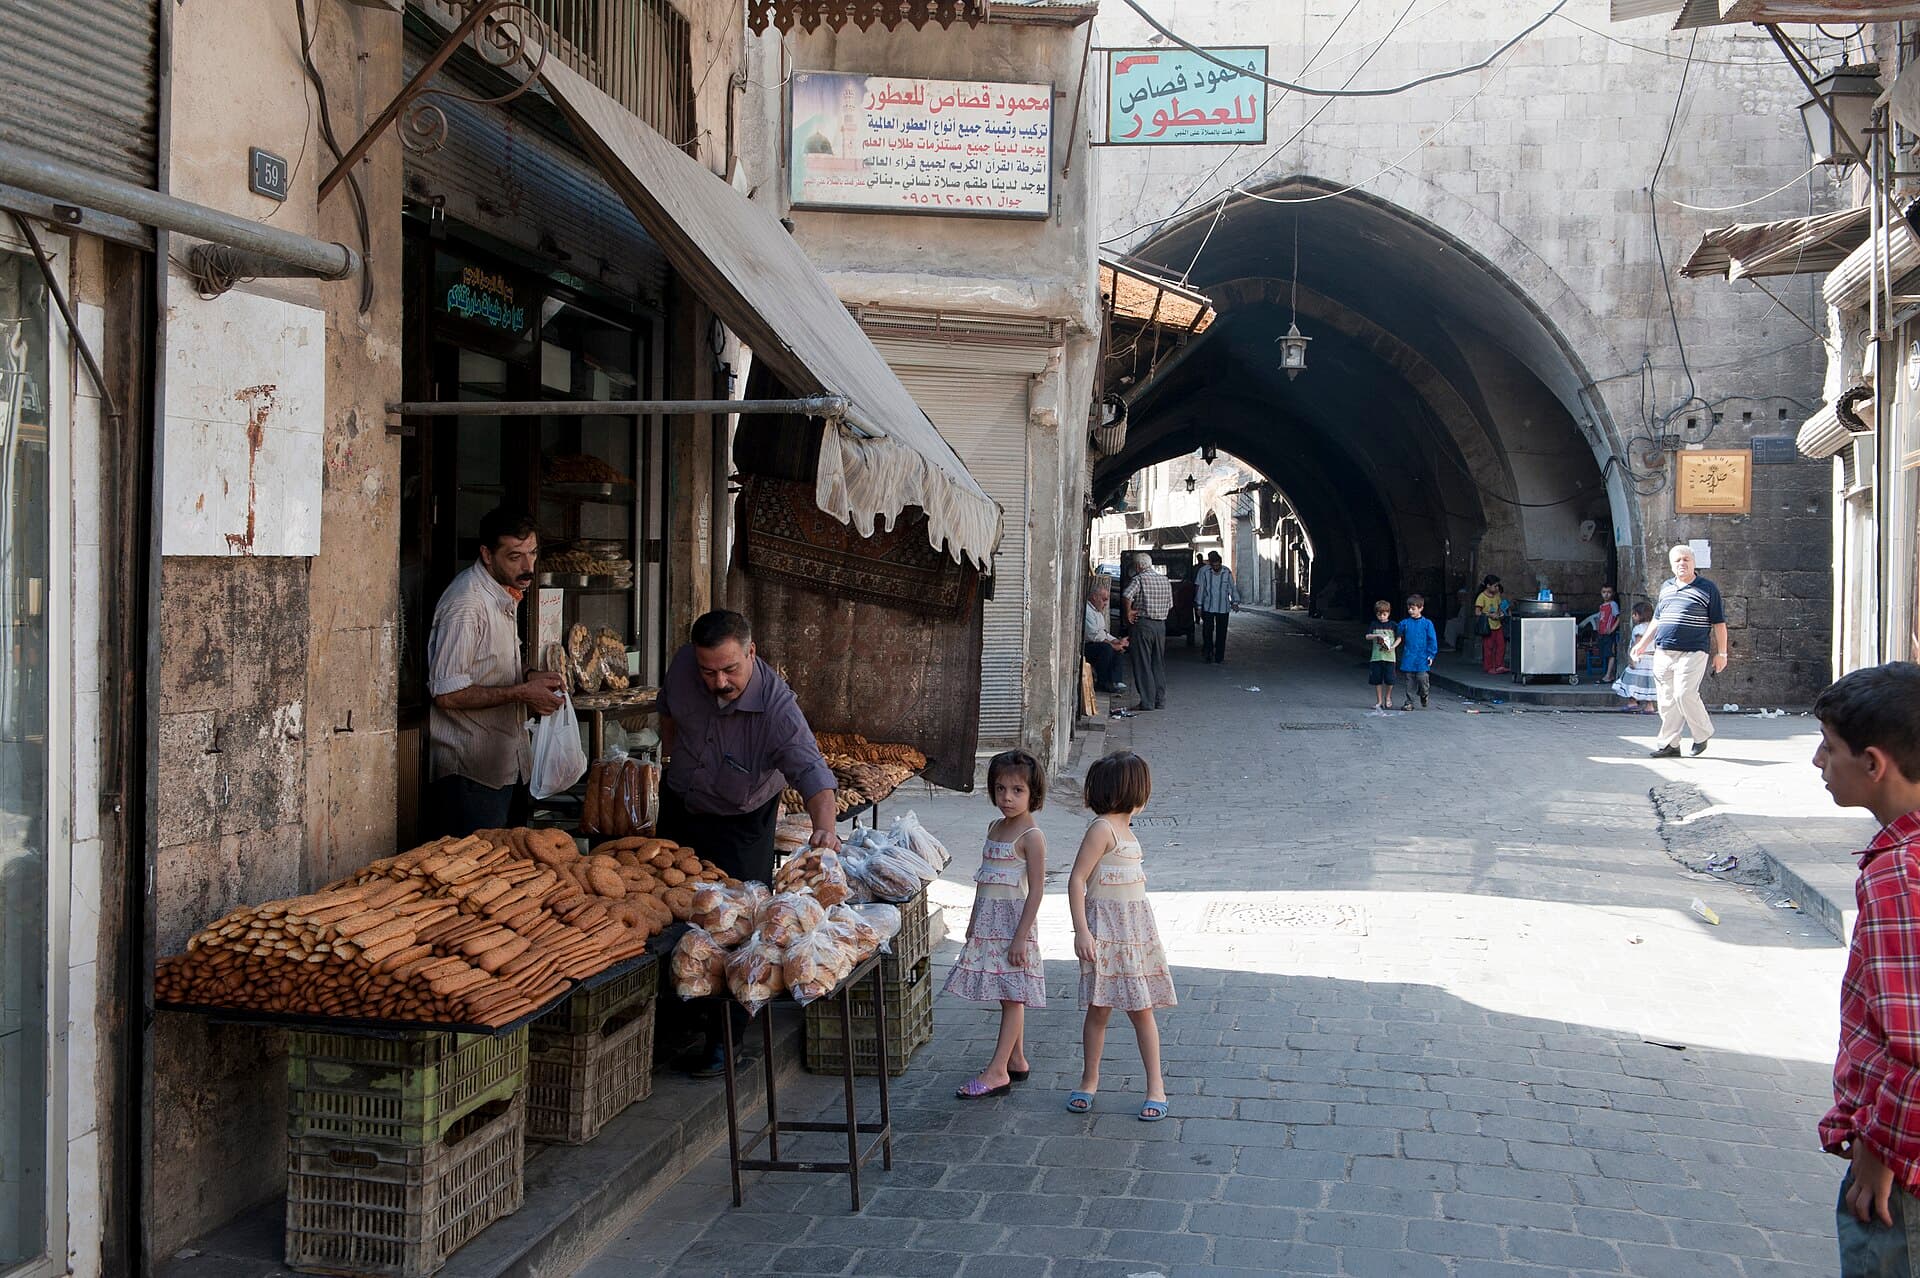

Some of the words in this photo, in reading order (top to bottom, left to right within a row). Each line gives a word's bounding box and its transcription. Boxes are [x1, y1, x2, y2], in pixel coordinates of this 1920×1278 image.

[864, 82, 925, 110] للعطور
[1119, 64, 1187, 114] قصاص
[929, 85, 990, 113] قصاص
[996, 95, 1050, 117] محمود
[867, 114, 899, 132] العالمية
[1119, 95, 1257, 138] للعطور
[900, 119, 930, 133] العطور
[958, 124, 982, 139] جميع
[1018, 123, 1048, 139] تركيب
[862, 137, 885, 150] العلم
[888, 138, 914, 151] طلاب
[917, 139, 962, 152] مستلزمات
[966, 144, 990, 156] جميع
[994, 141, 1018, 156] لدينا
[1021, 145, 1046, 158] يوجد
[895, 156, 916, 170] قراء
[919, 159, 946, 172] لجميع
[949, 158, 982, 173] الكريم
[265, 162, 278, 187] 59
[867, 171, 893, 188] بناتي
[934, 176, 960, 189] صلاة
[963, 178, 988, 191] طقم
[992, 178, 1018, 193] لدينا
[1021, 182, 1046, 195] يوجد
[997, 195, 1023, 208] جوال
